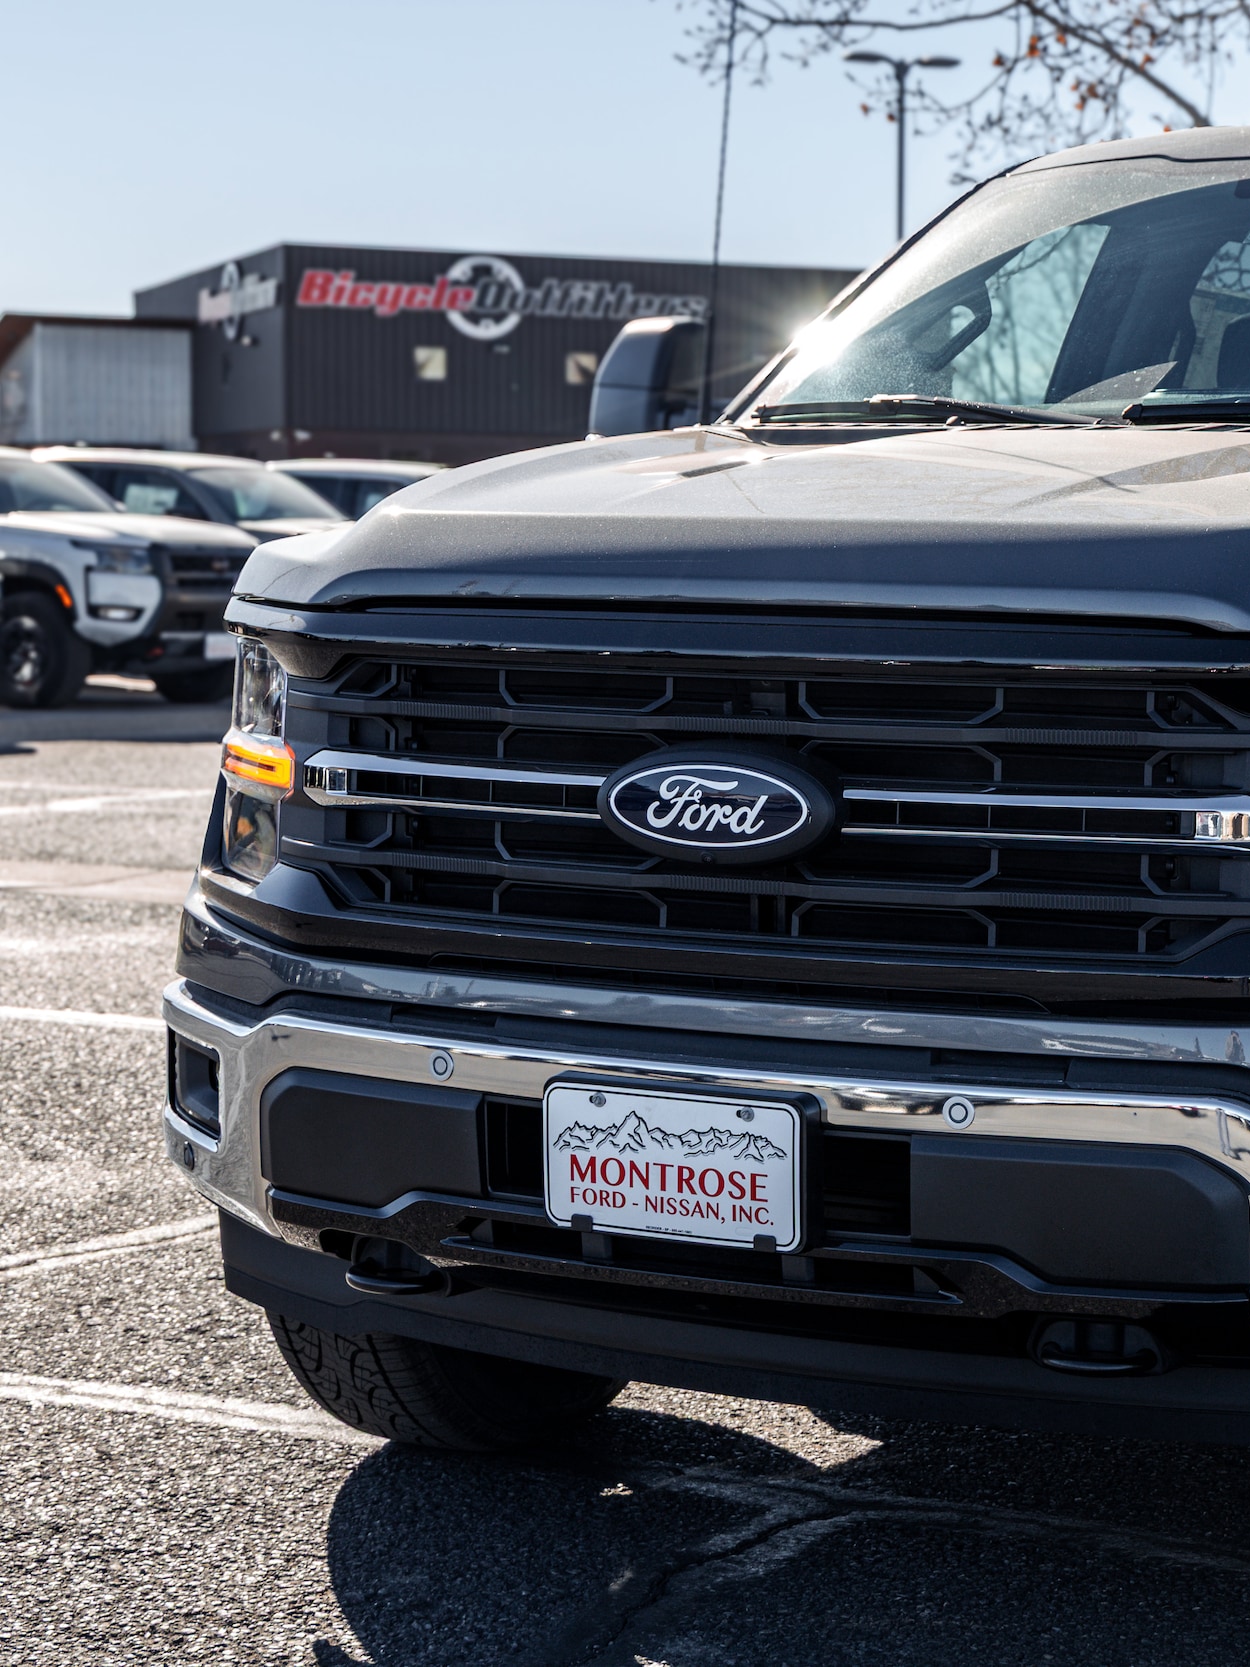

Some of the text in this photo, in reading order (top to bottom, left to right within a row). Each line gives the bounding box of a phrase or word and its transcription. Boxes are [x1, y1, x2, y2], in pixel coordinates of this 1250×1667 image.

[297, 270, 475, 317] Bicycle
[646, 774, 769, 835] Ford
[569, 1153, 769, 1203] MONTROSE
[570, 1186, 627, 1209] FORD
[644, 1195, 725, 1226] NISSAN,
[731, 1204, 774, 1226] INC.
